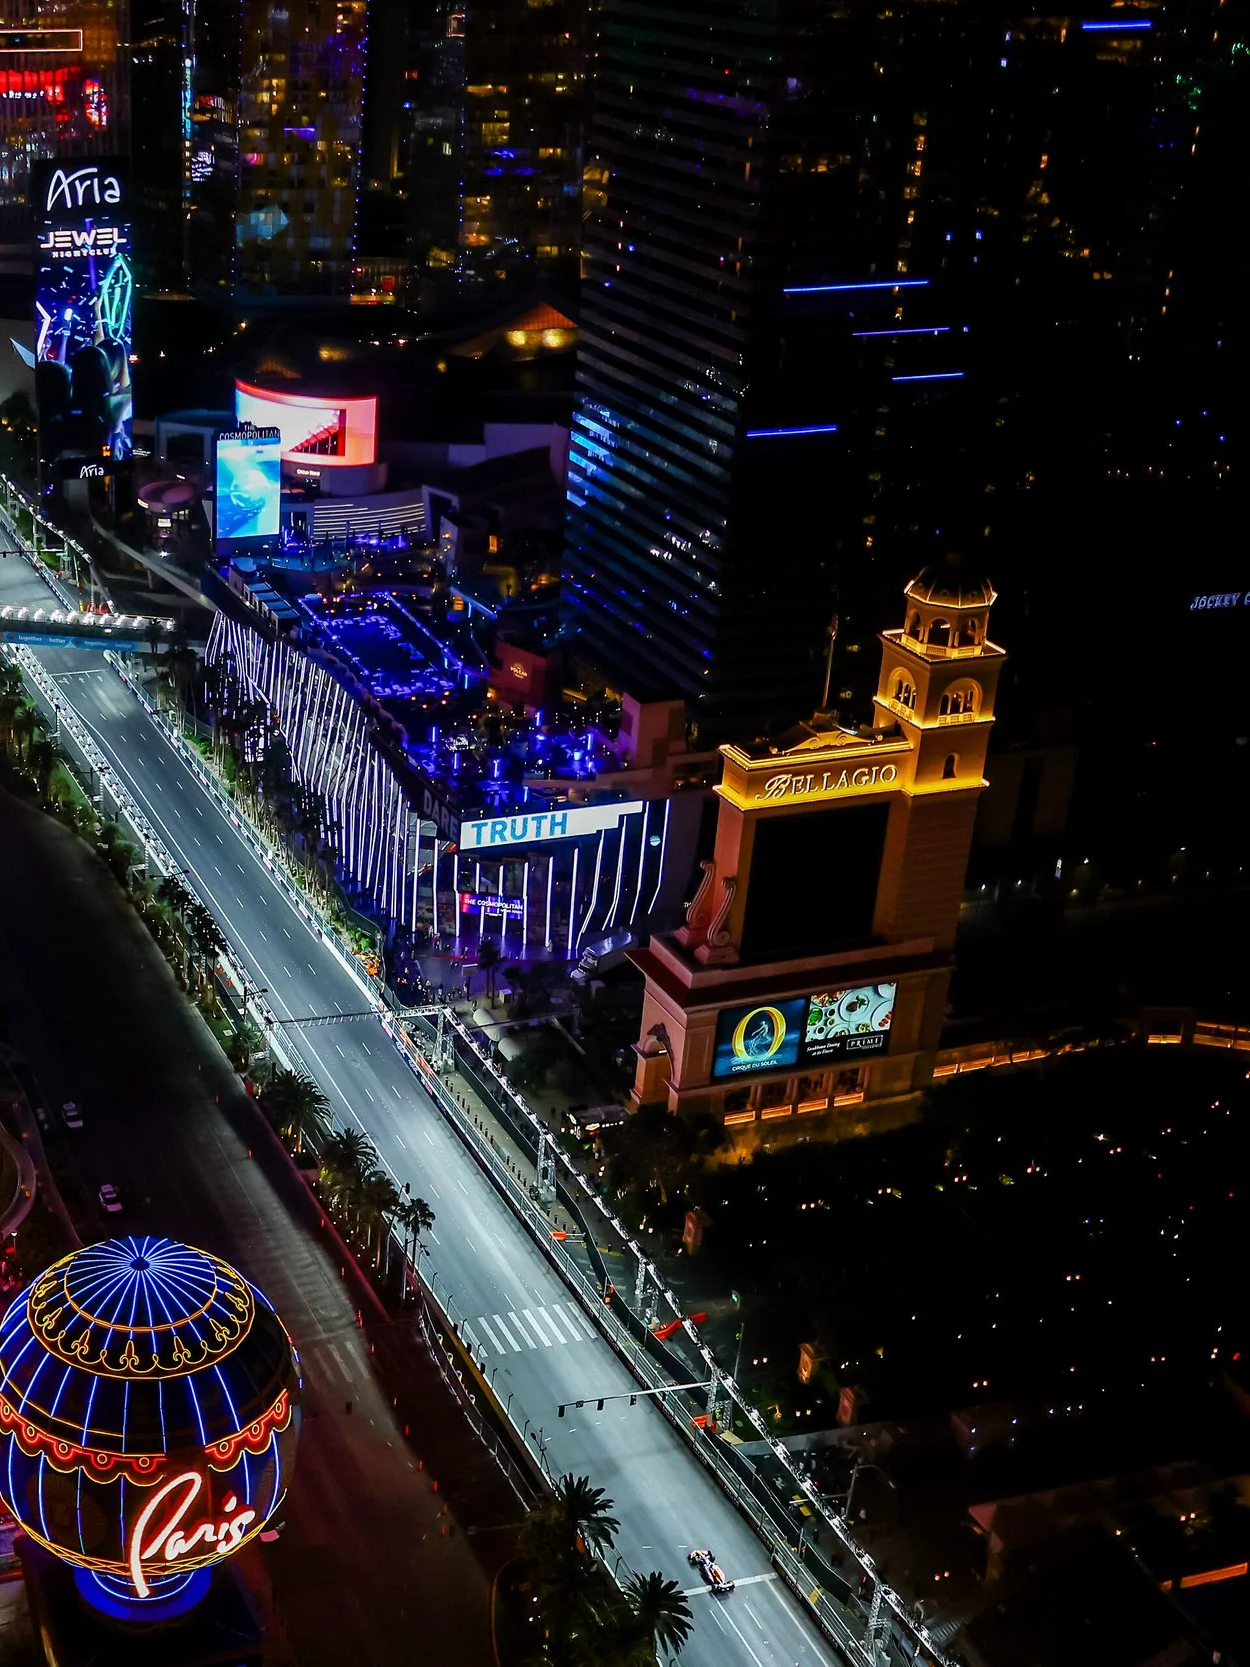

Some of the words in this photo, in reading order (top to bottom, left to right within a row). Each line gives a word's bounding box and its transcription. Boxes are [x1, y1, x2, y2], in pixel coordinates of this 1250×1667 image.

[46, 167, 120, 211] Aria
[40, 227, 127, 249] JEWEL
[52, 247, 117, 258] NIGHTCLUB
[219, 429, 280, 441] COSMOPOLITAN
[79, 464, 104, 479] Aria
[1190, 593, 1241, 610] JOCKEY
[754, 764, 898, 800] BELLAGIO
[471, 812, 568, 846] TRUTH
[477, 899, 523, 910] COSMOPOLITAN
[850, 1037, 879, 1047] PRIME
[732, 1064, 752, 1072] CIRQUE
[760, 1059, 778, 1067] SOLEIL
[130, 1471, 256, 1599] Paris
